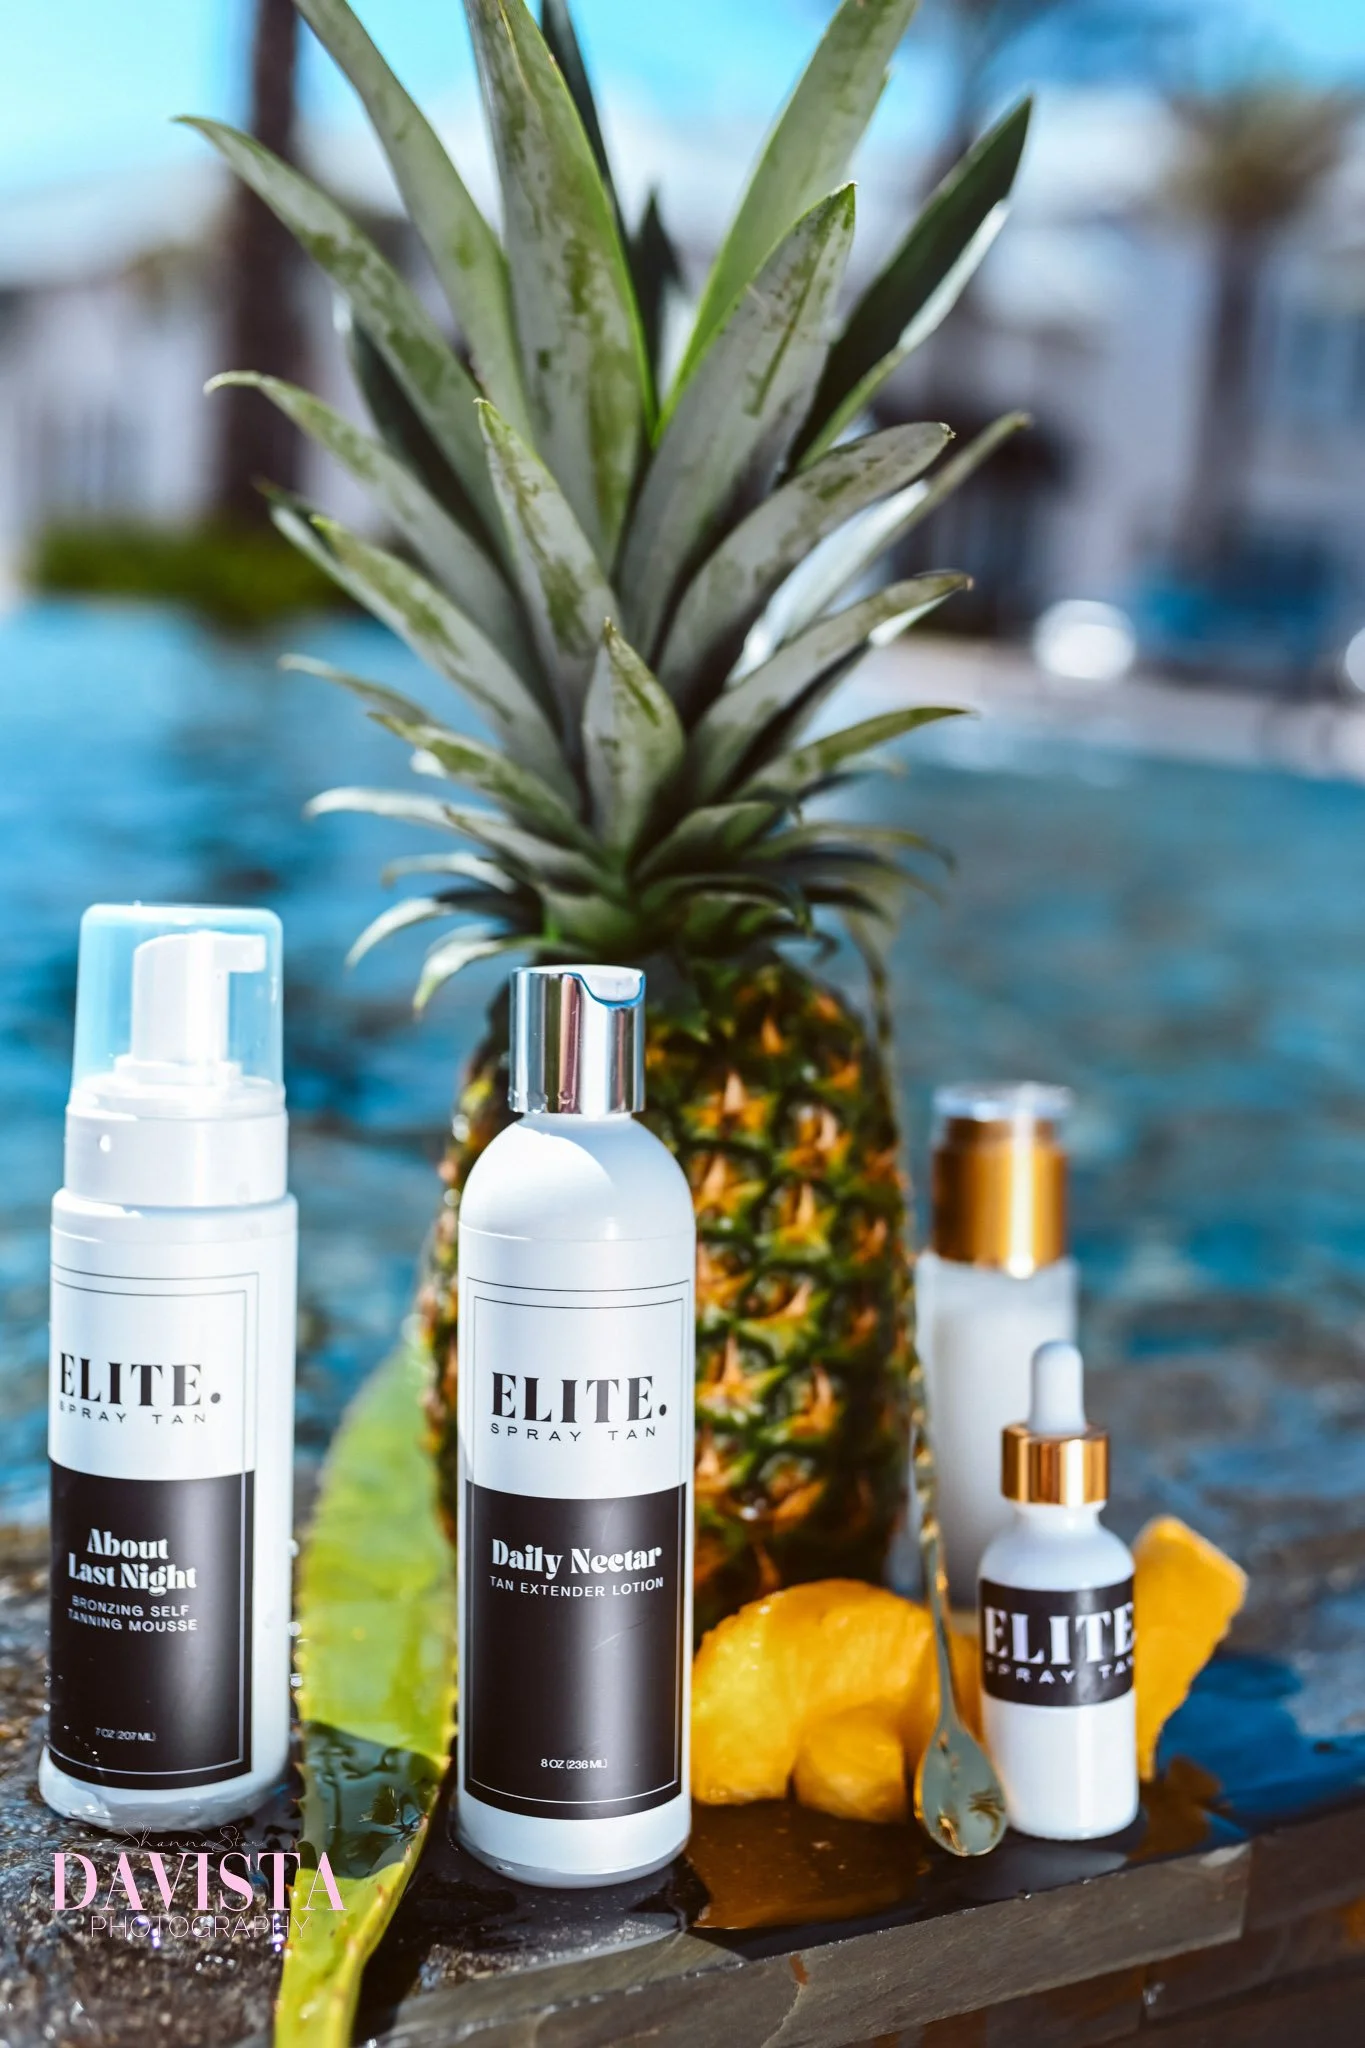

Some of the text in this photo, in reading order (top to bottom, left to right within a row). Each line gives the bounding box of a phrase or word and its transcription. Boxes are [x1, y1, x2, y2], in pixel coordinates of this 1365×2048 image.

[60, 1352, 221, 1406] ELITE.
[491, 1371, 667, 1424] ELITE.
[60, 1400, 206, 1425] SPRAY TAN
[490, 1422, 657, 1442] SPRAY TAN
[86, 1528, 169, 1560] About
[491, 1538, 663, 1581] Daily Nectar
[68, 1552, 197, 1597] Last Night
[489, 1575, 664, 1598] TAN EXTENDER LOTION
[71, 1594, 190, 1618] BRONZING SELF
[67, 1608, 198, 1633] TANNING MOUSSE
[540, 1758, 548, 1768] 8
[548, 1759, 565, 1769] OZ
[566, 1759, 588, 1770] (236
